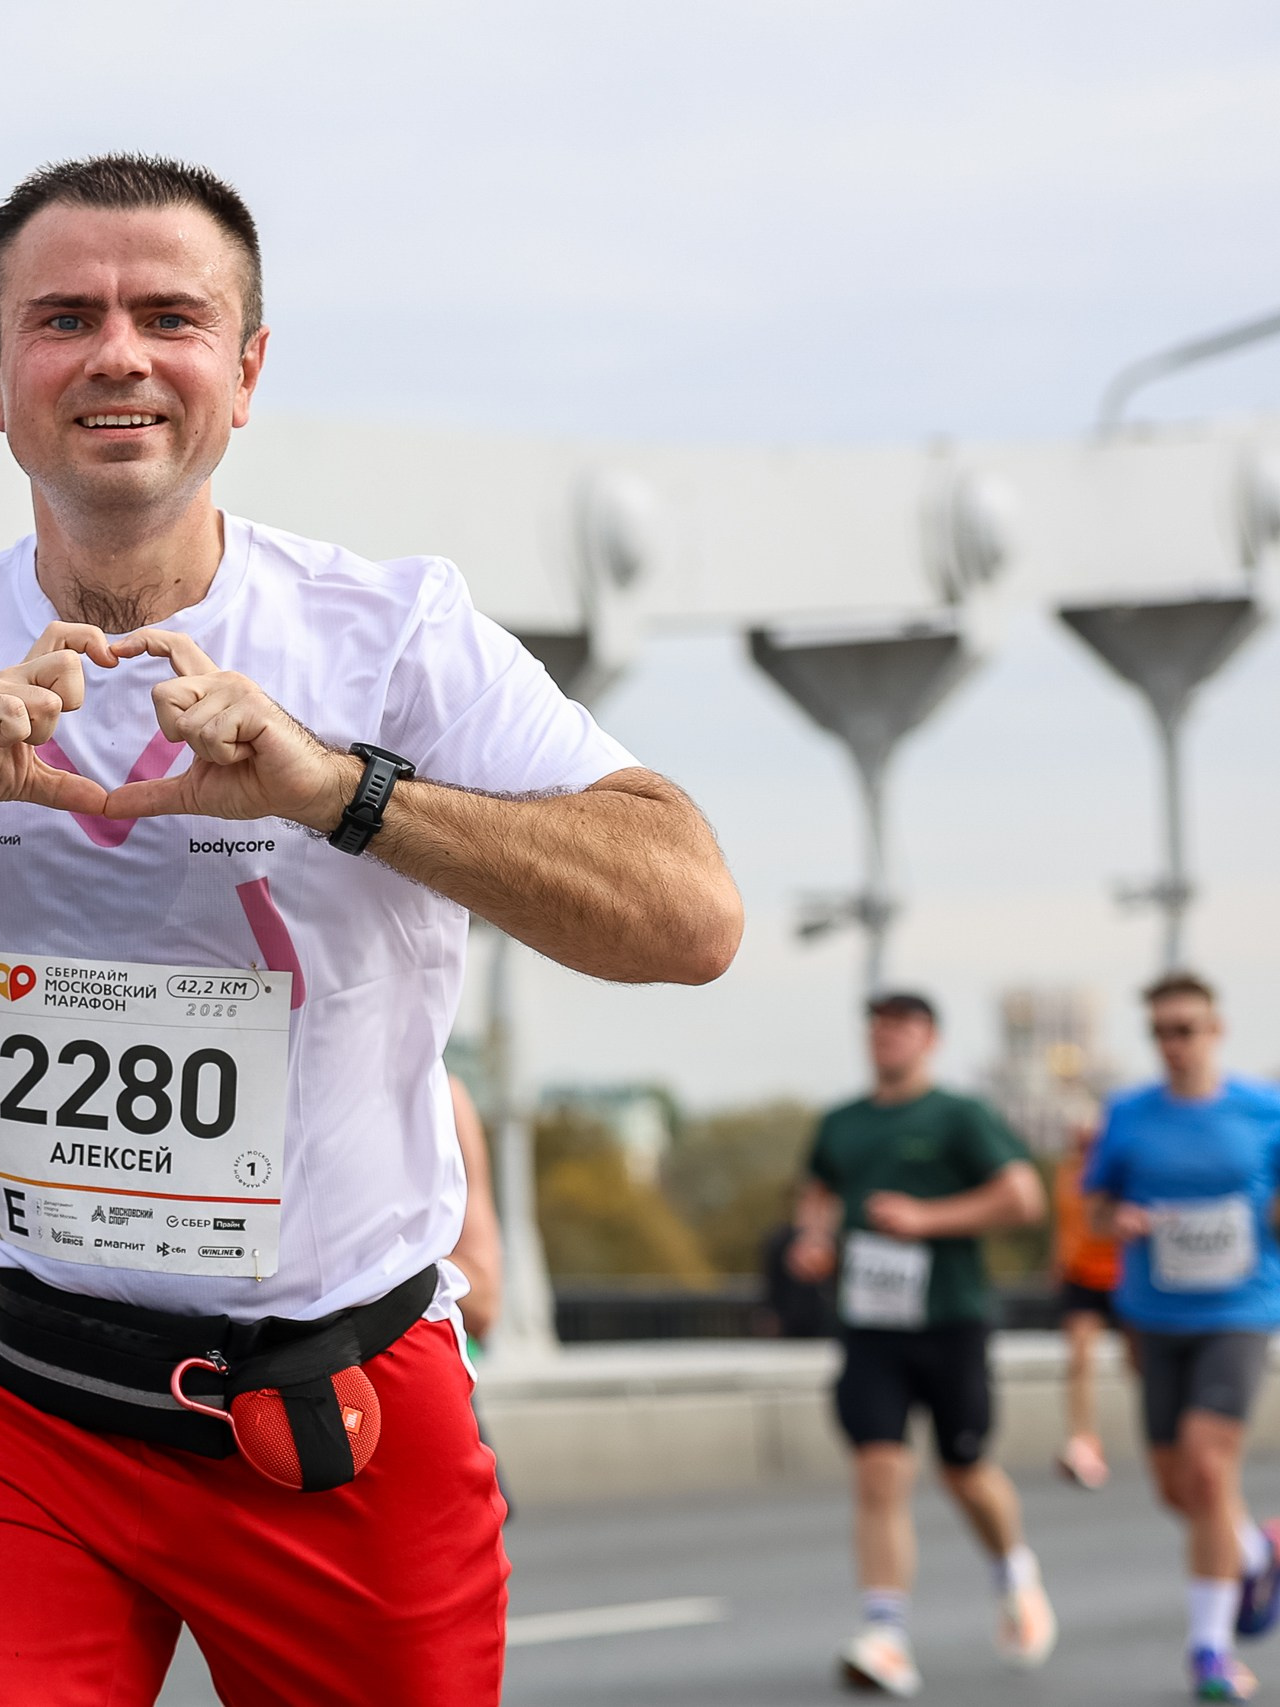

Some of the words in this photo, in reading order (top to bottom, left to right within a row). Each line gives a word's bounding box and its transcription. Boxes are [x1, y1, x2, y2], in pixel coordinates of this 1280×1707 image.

[189, 837, 276, 857] bodycore
[45, 966, 129, 983] СБЕРПРАЙМ
[44, 979, 158, 1000] МОСКОВСКИЙ
[176, 980, 215, 996] 42,2
[44, 993, 127, 1012] МАРАФОН
[0, 1033, 238, 1140] 2280
[49, 1141, 173, 1174] АЛЕКСЕЙ
[246, 1162, 256, 1177] 1
[109, 1206, 154, 1219] МОСКОВСКИЙ
[108, 1216, 129, 1226] СПОРТ
[181, 1218, 211, 1228] СБЕР
[62, 1238, 84, 1247] BRICS
[345, 1413, 358, 1428] JBL
